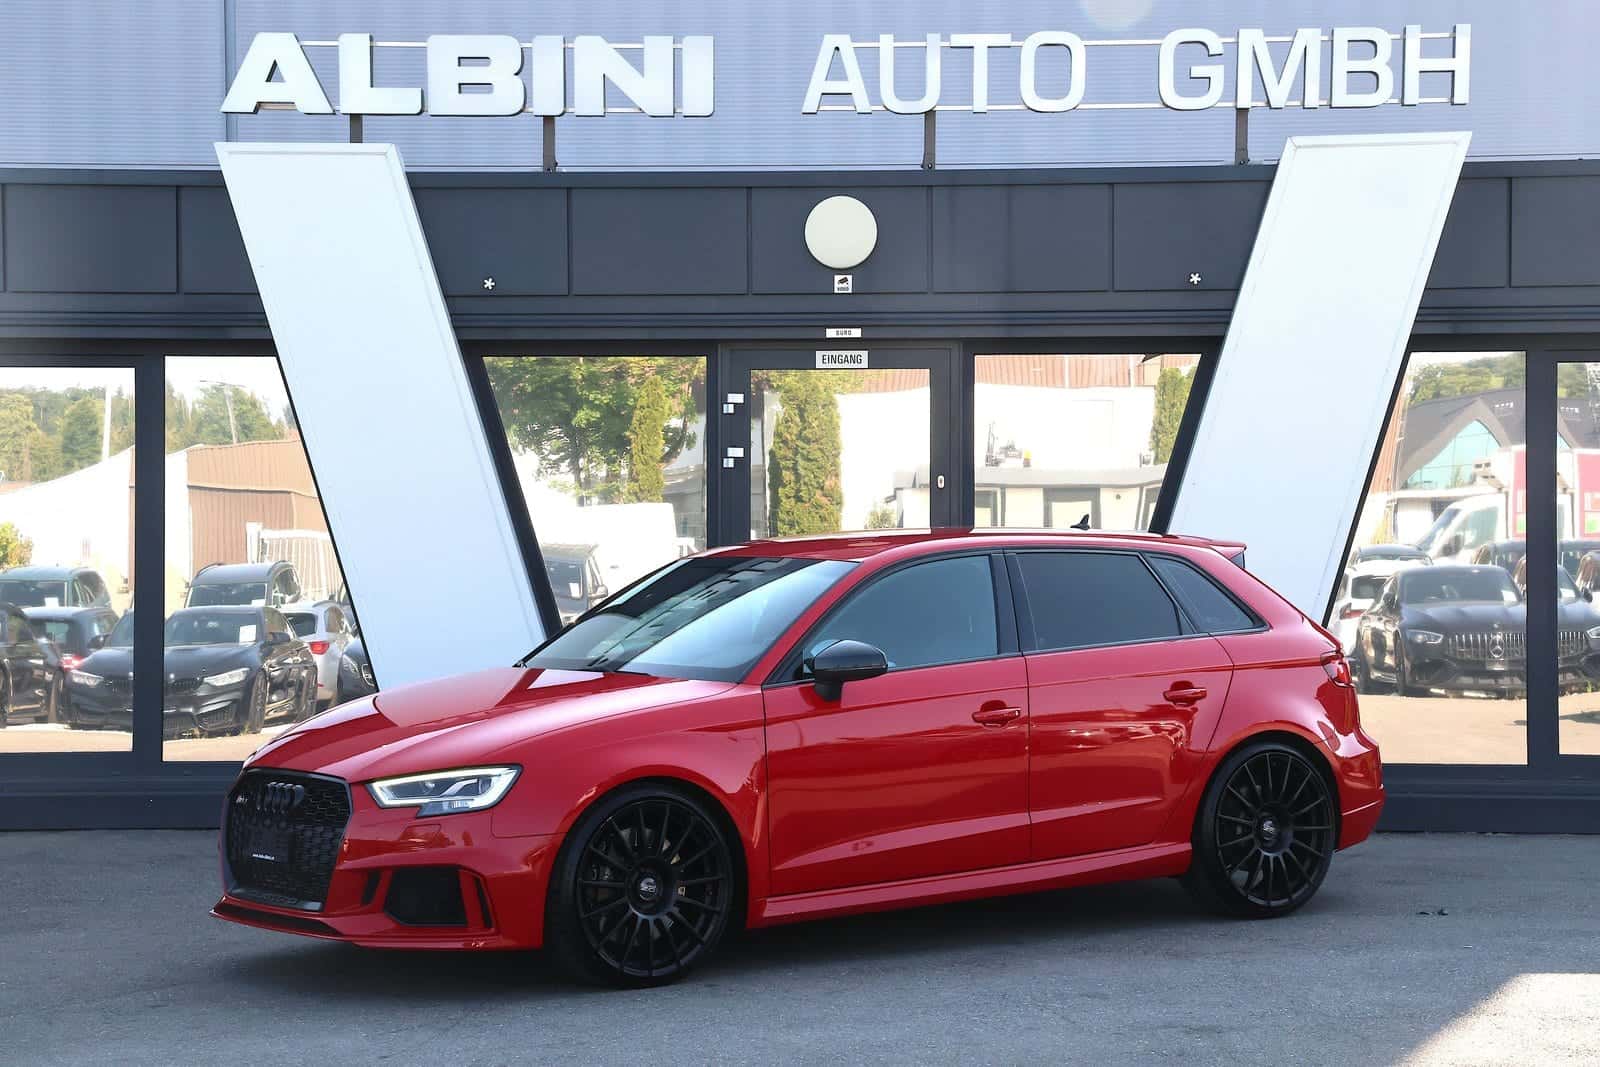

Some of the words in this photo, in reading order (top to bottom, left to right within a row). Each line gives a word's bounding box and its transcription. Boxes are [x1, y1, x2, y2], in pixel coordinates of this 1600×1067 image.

[220, 32, 714, 117] ALBINI
[802, 31, 1086, 114] AUTO
[1158, 24, 1471, 111] GMBH
[821, 354, 862, 365] EINGANG
